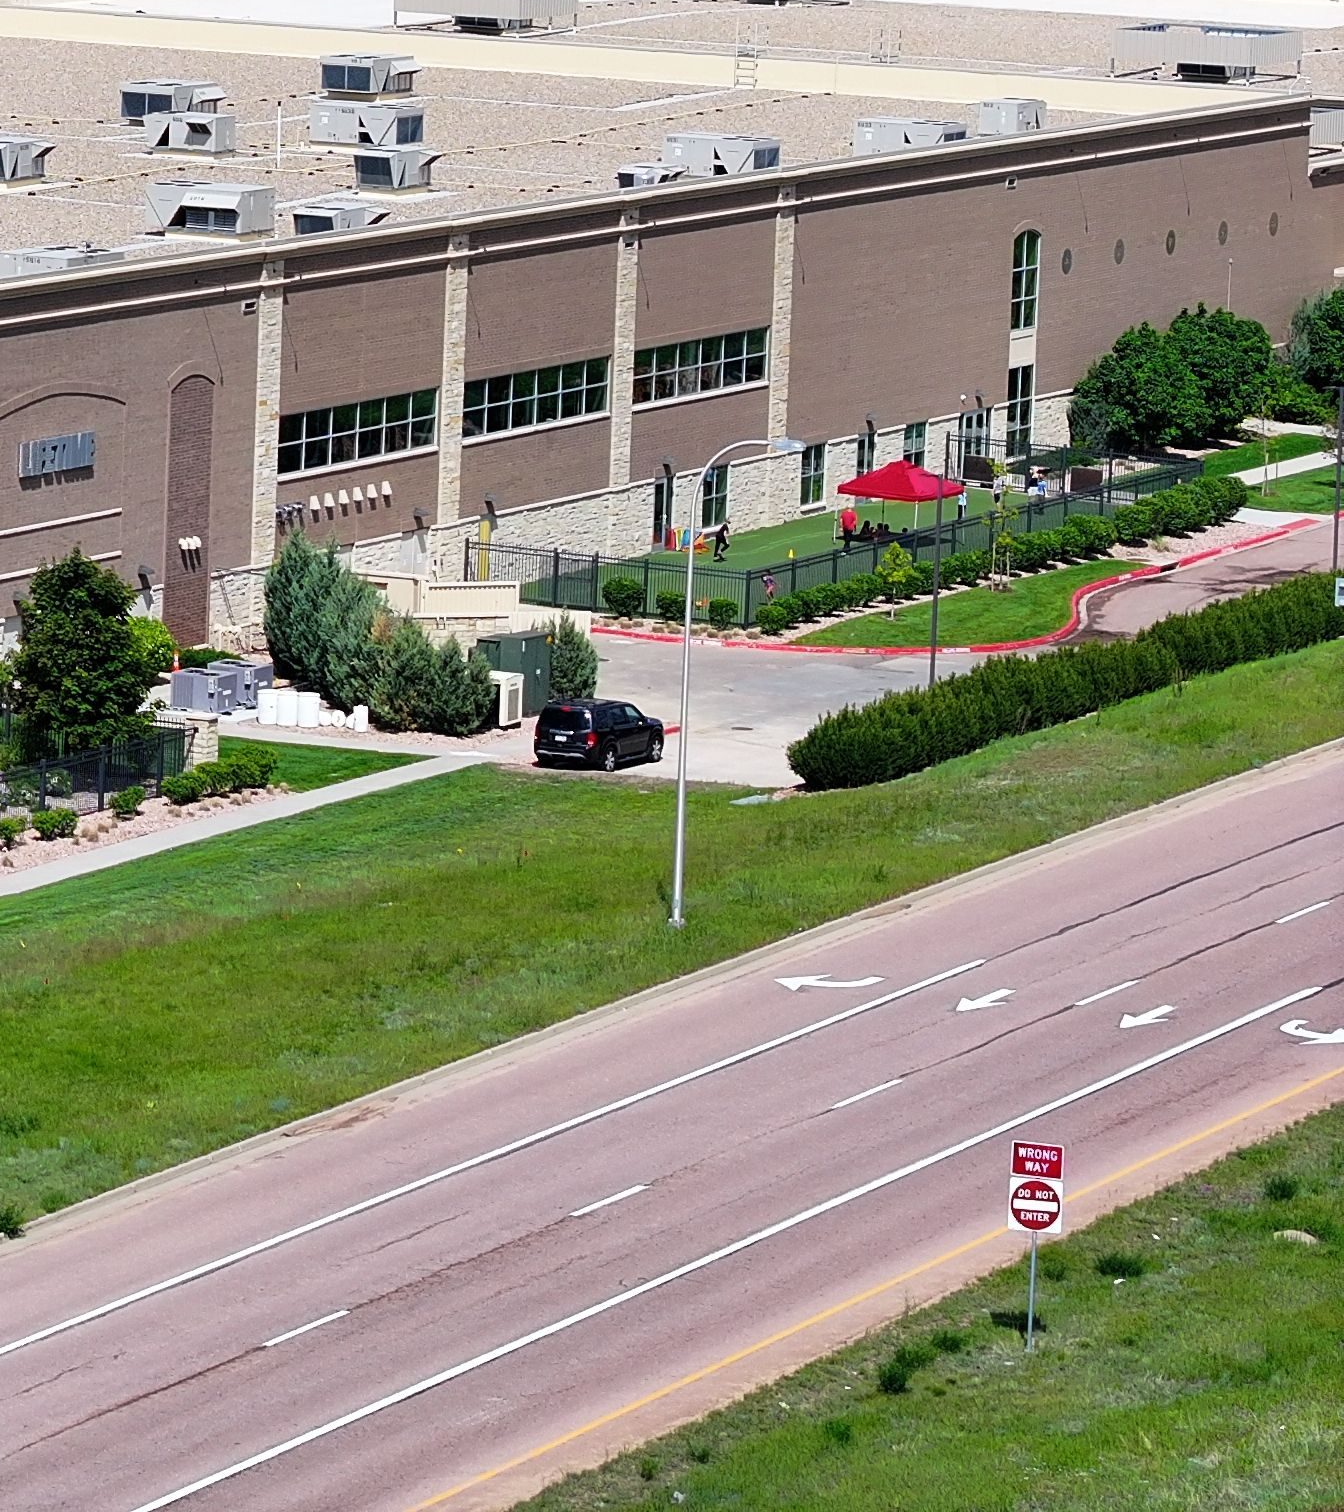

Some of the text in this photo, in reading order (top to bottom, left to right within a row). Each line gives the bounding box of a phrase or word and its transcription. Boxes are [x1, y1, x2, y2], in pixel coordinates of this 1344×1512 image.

[18, 430, 96, 478] LIFETIME
[1017, 1146, 1058, 1162] WRONG
[1024, 1160, 1050, 1173] WAY
[1017, 1188, 1055, 1200] DO NOT
[1020, 1211, 1050, 1222] ENTER
